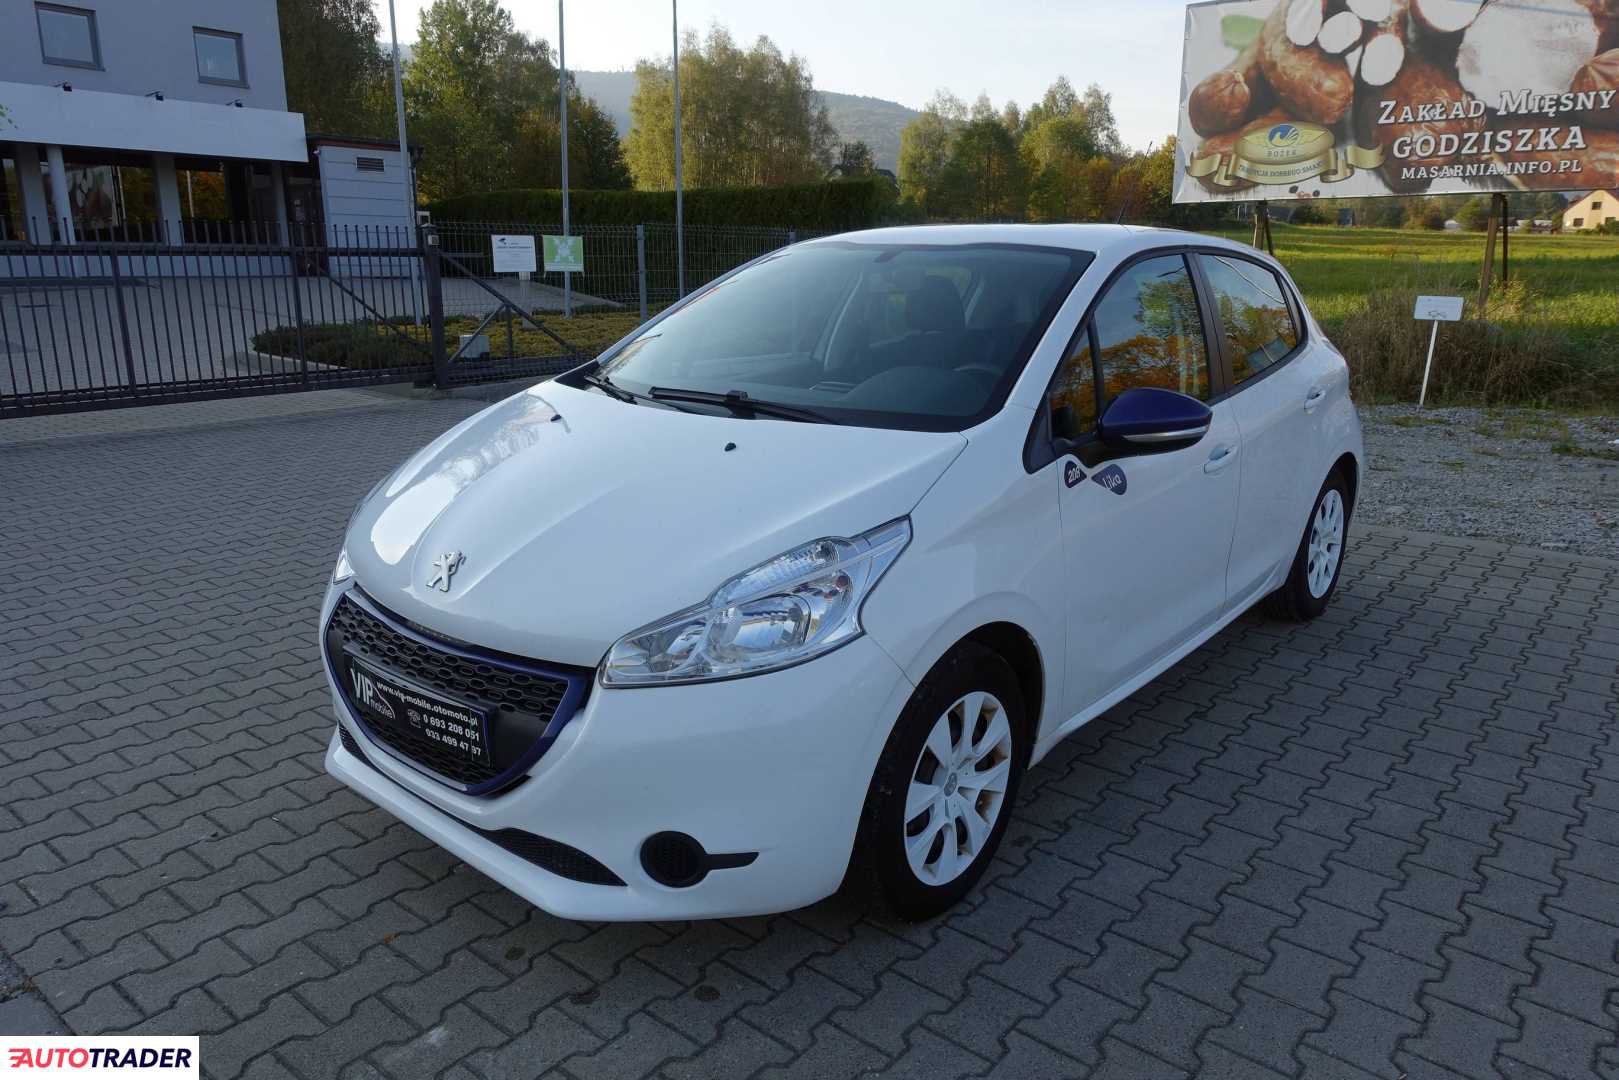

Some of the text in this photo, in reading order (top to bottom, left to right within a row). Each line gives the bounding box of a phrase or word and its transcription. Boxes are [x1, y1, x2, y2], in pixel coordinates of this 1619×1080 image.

[1377, 89, 1617, 125] ZAKŁAD MIĘSNY
[1393, 125, 1587, 159] GODZISZKA
[1401, 159, 1582, 180] MASARNIA.INFO.PL
[350, 668, 374, 706] VIP
